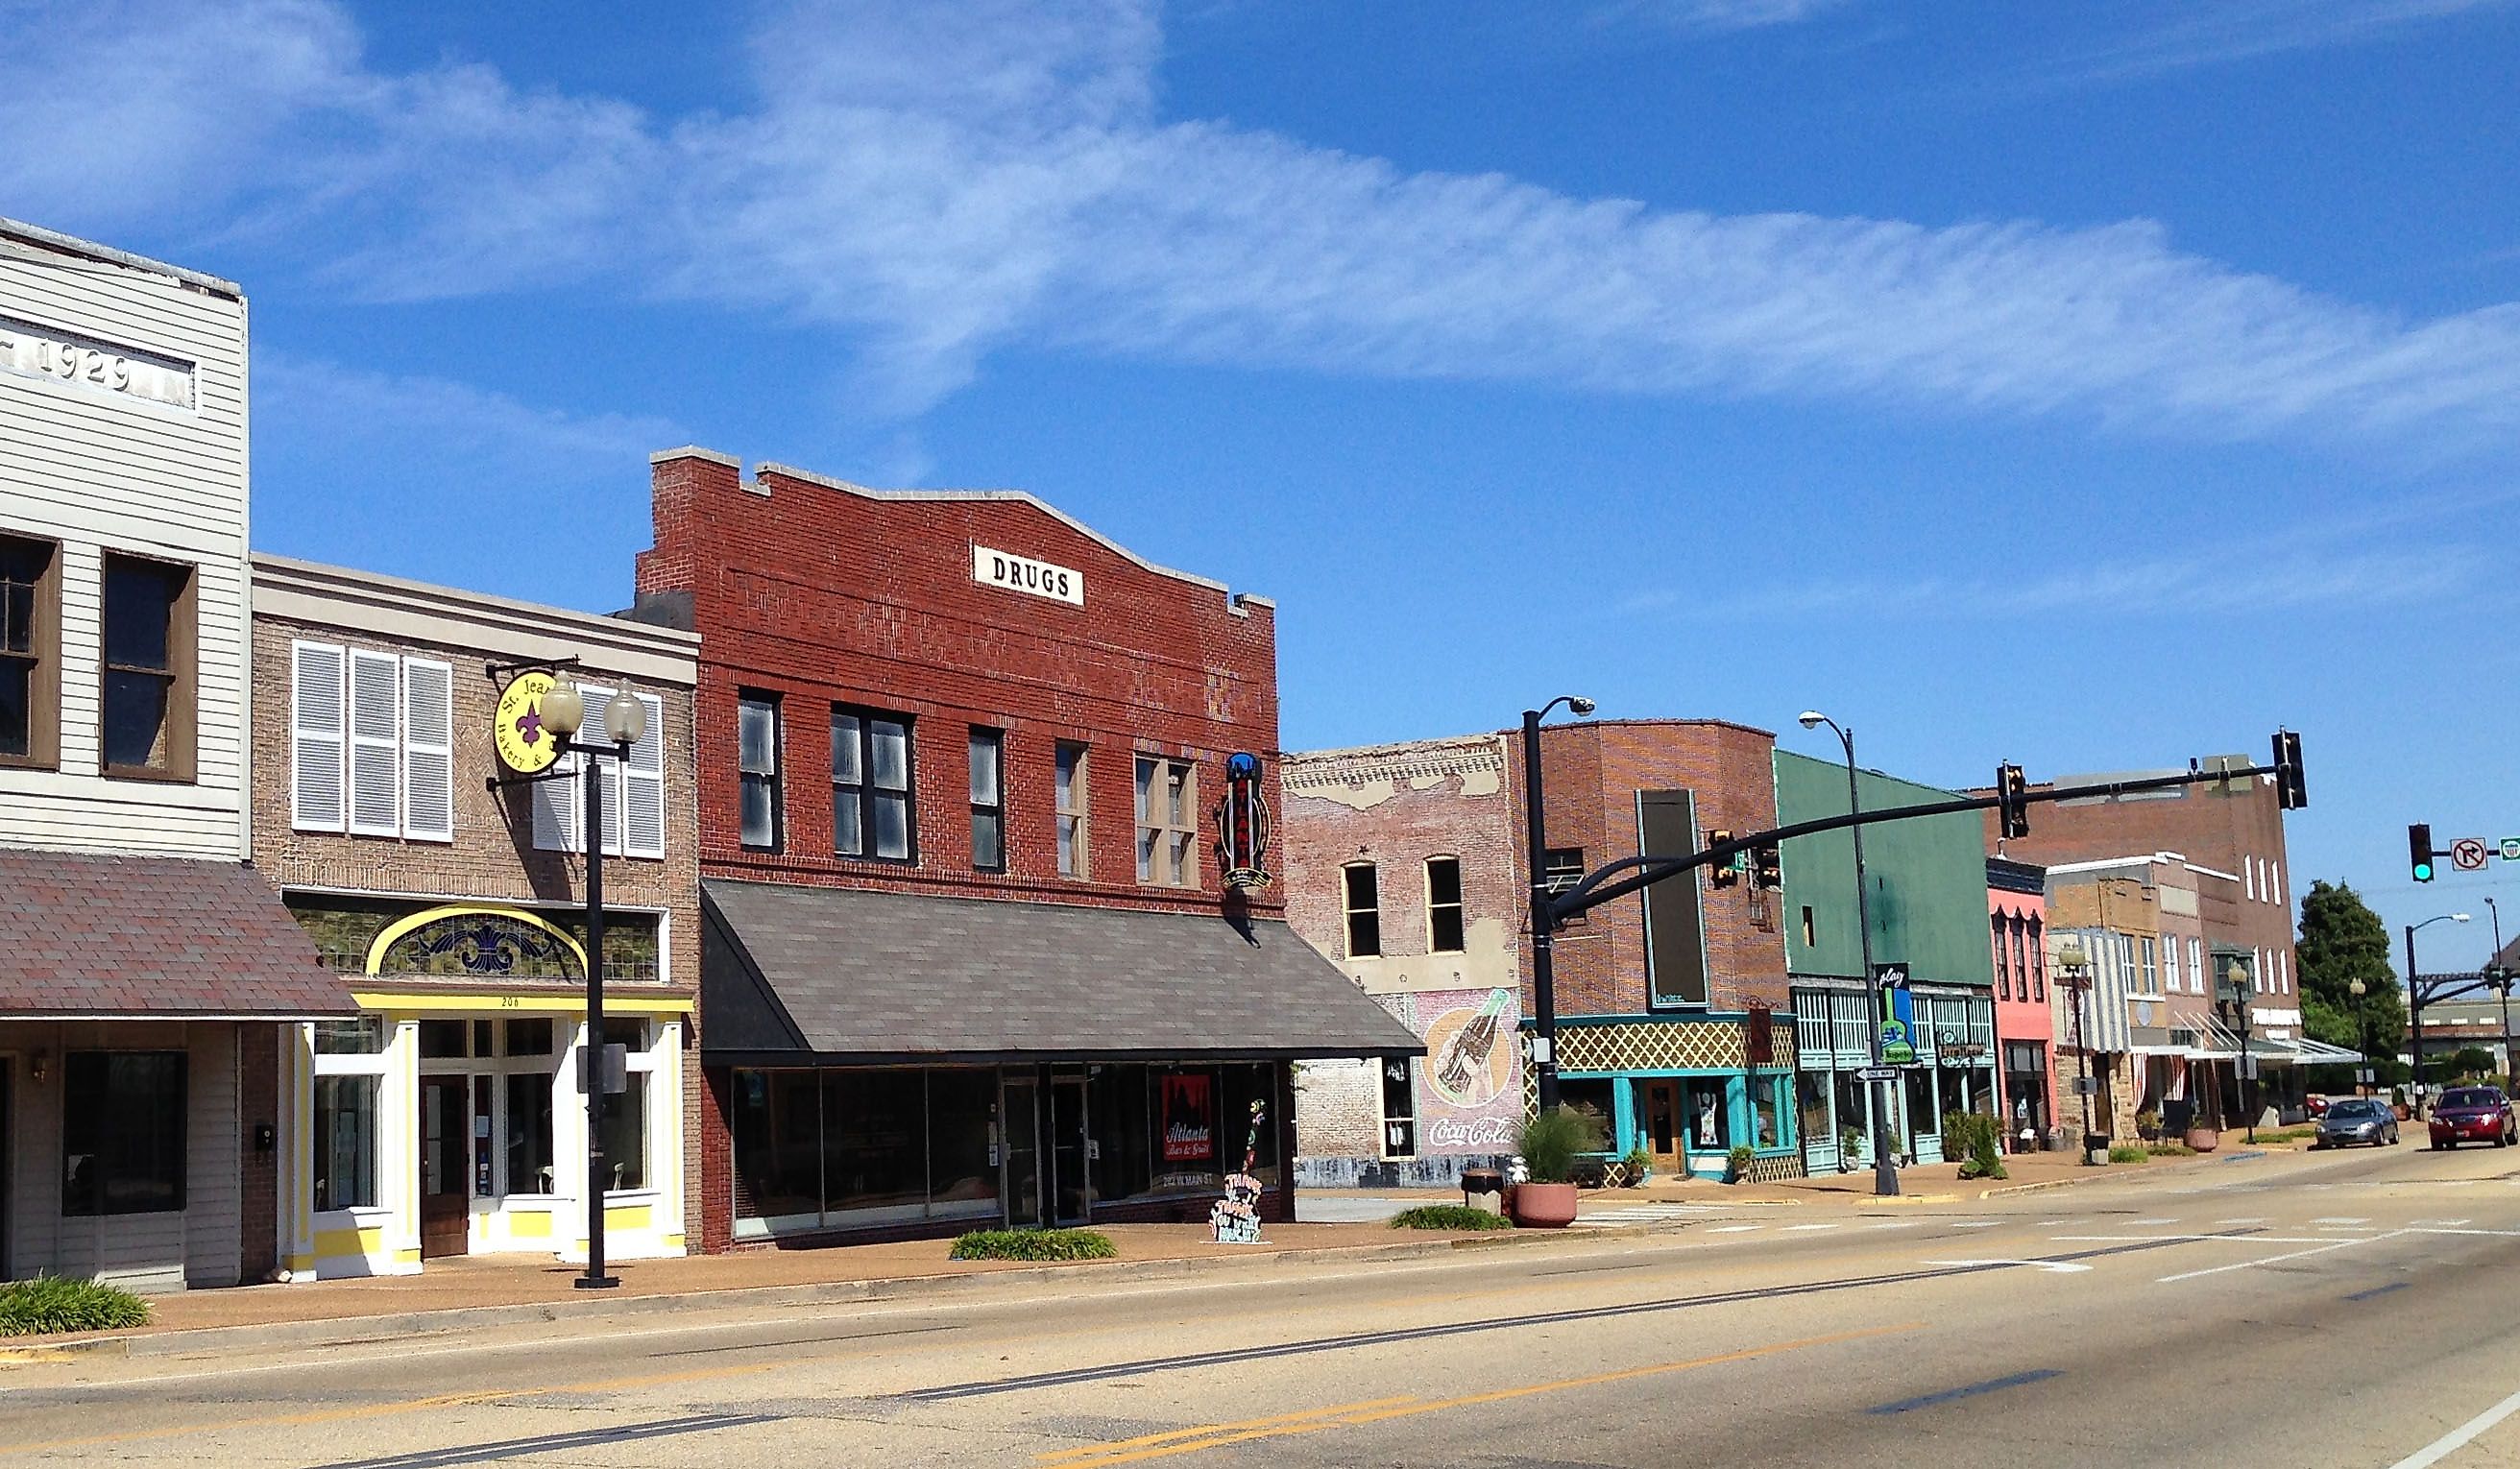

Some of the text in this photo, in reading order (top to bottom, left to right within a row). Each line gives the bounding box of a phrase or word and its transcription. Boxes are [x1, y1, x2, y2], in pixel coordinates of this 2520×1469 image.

[39, 342, 130, 392] 1929
[993, 556, 1069, 596] DRUGS
[502, 695, 520, 714] St.
[497, 723, 525, 768] Bakery
[1236, 778, 1248, 868] ATLANTA
[1878, 967, 1904, 990] play
[1166, 1121, 1209, 1143] Atlanta
[1166, 1144, 1183, 1156] Bar
